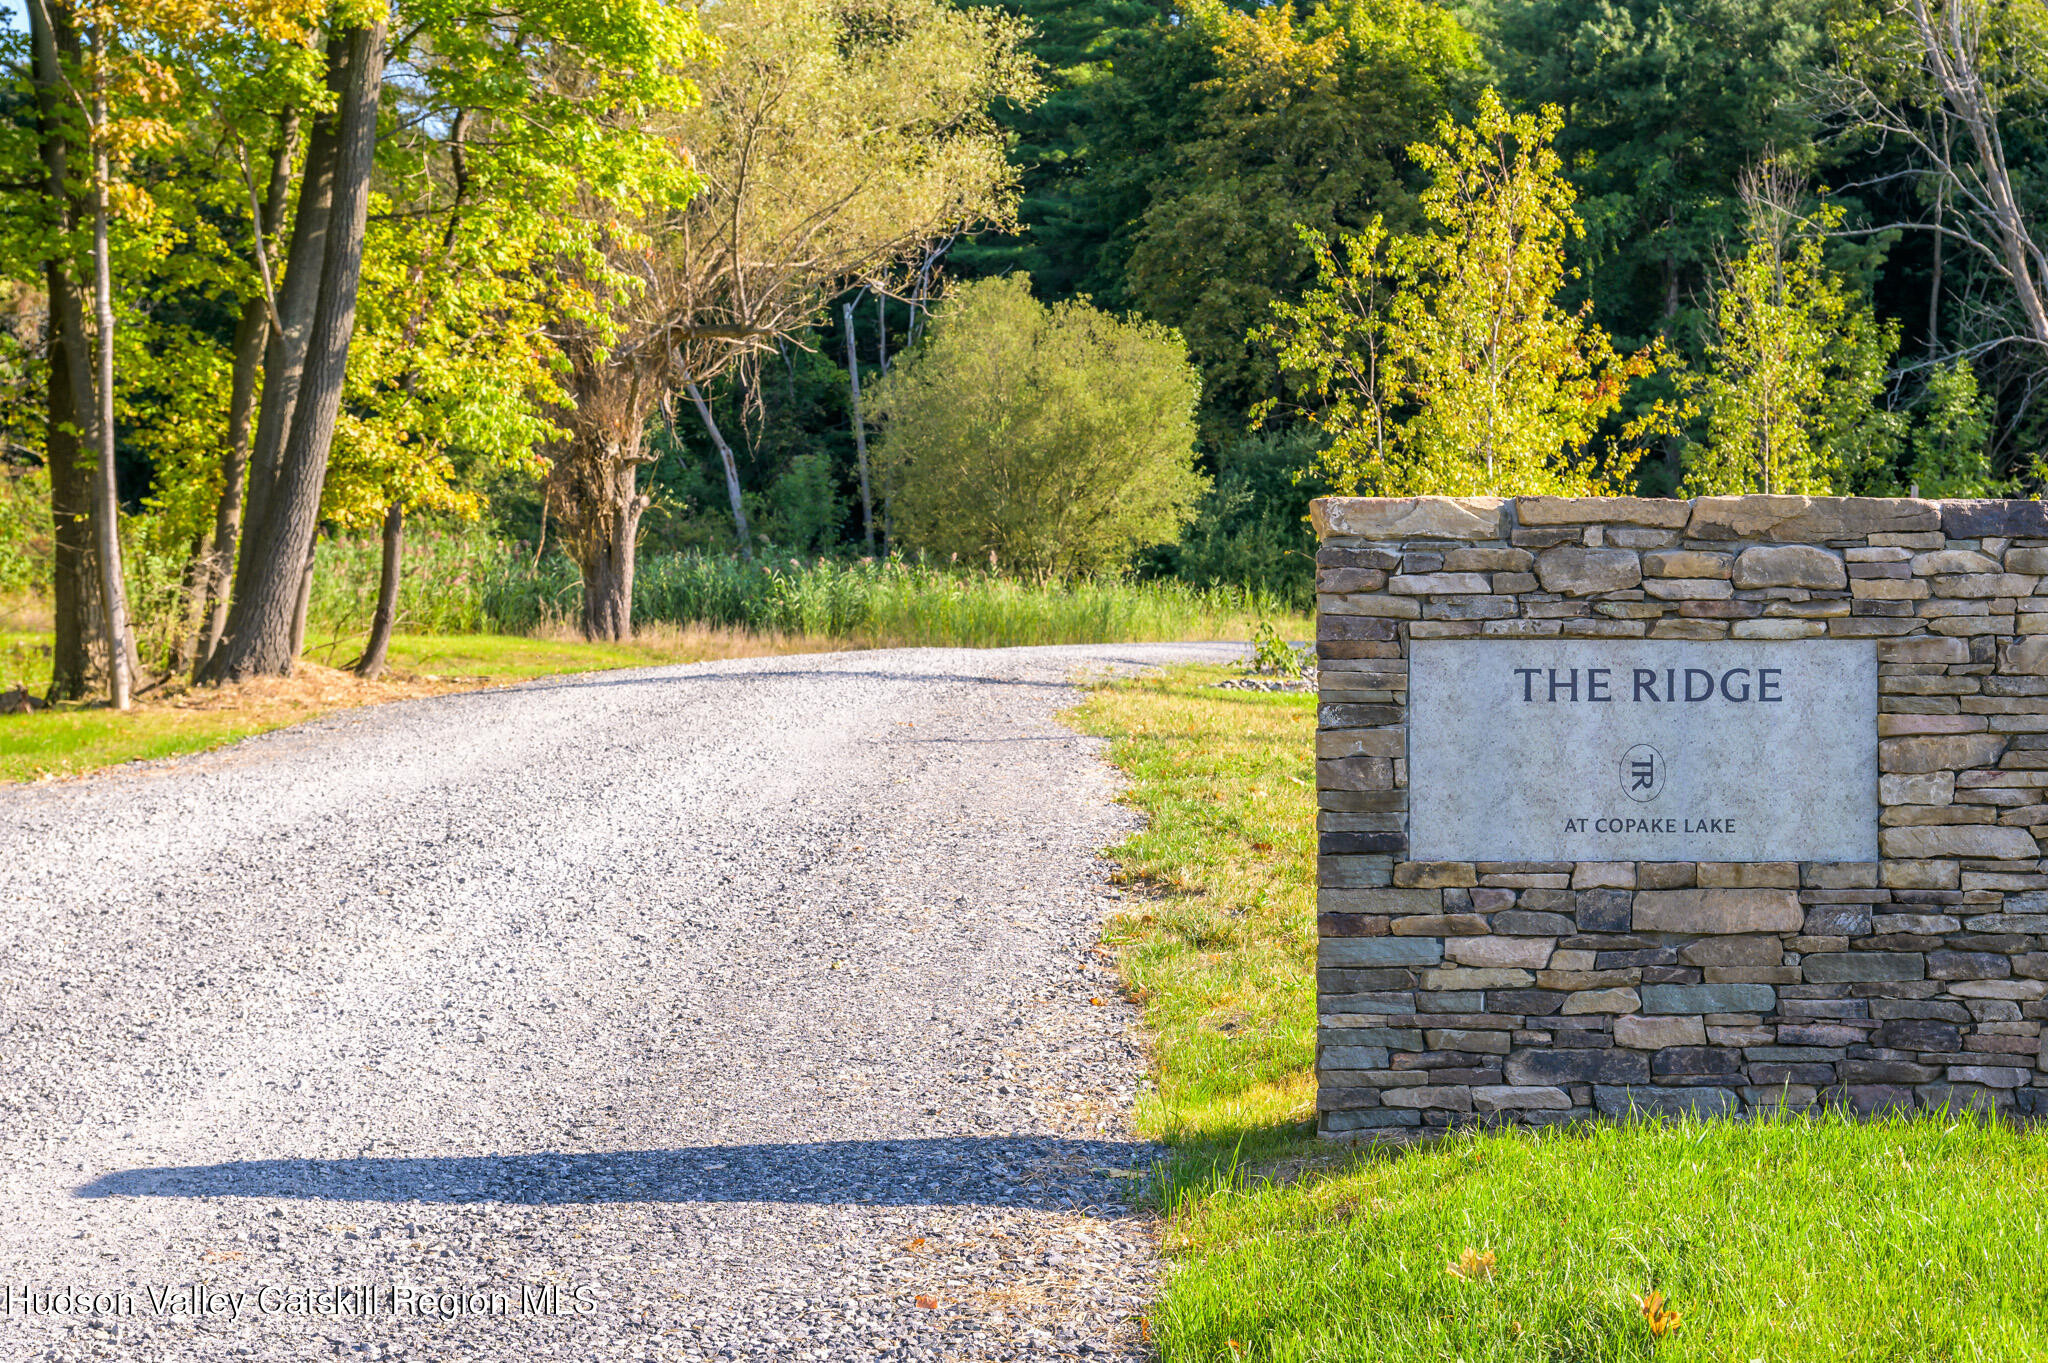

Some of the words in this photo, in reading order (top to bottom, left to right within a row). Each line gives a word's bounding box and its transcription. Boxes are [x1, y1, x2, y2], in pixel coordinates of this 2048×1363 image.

[1513, 668, 1612, 702] THE
[1632, 668, 1783, 702] RIDGE
[1563, 818, 1586, 834] AT
[1595, 817, 1677, 834] COPAKE
[1684, 818, 1737, 834] LAKE
